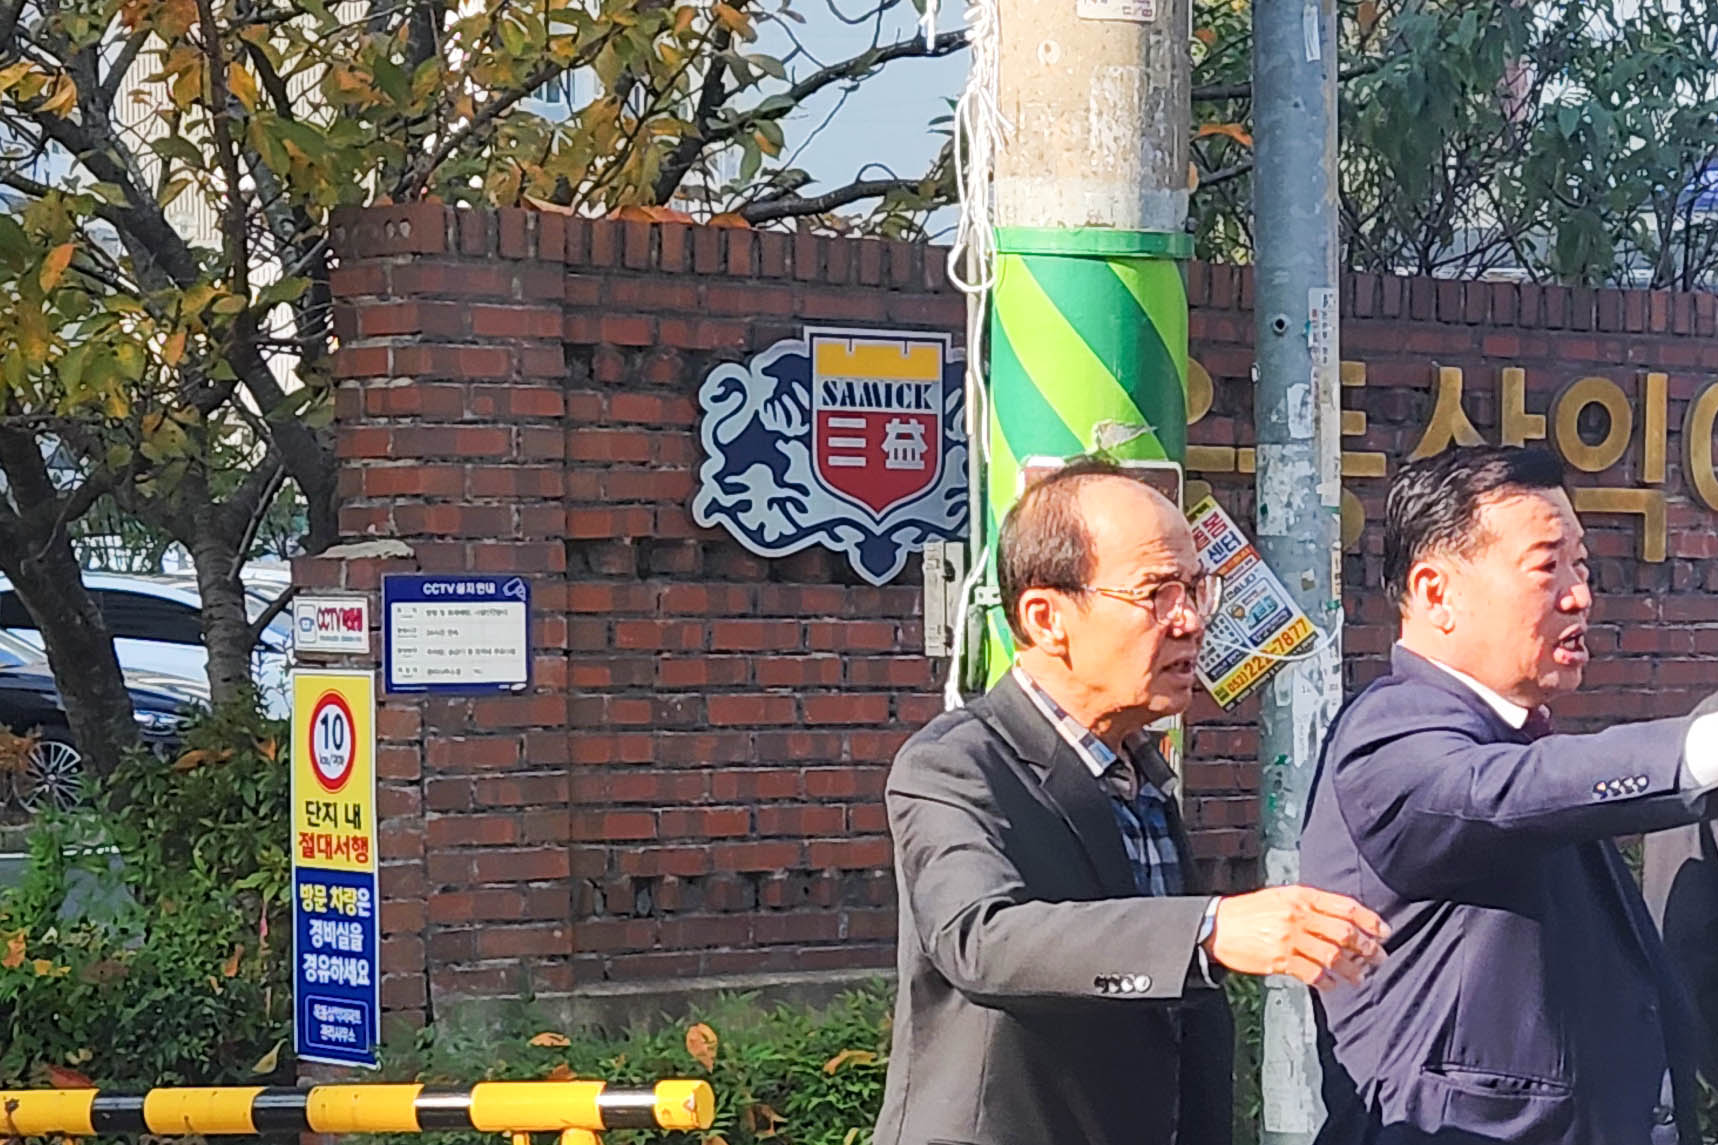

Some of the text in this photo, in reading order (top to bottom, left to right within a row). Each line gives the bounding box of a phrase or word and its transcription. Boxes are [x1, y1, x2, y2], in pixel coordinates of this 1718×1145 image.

[822, 380, 933, 410] SAMICK
[320, 712, 345, 751] 10
[305, 800, 362, 830] 단지 내
[298, 832, 369, 864] 절대서행
[299, 883, 372, 918] 방문 차량은
[309, 919, 364, 952] 경비실을
[303, 953, 370, 988] 경유하세요
